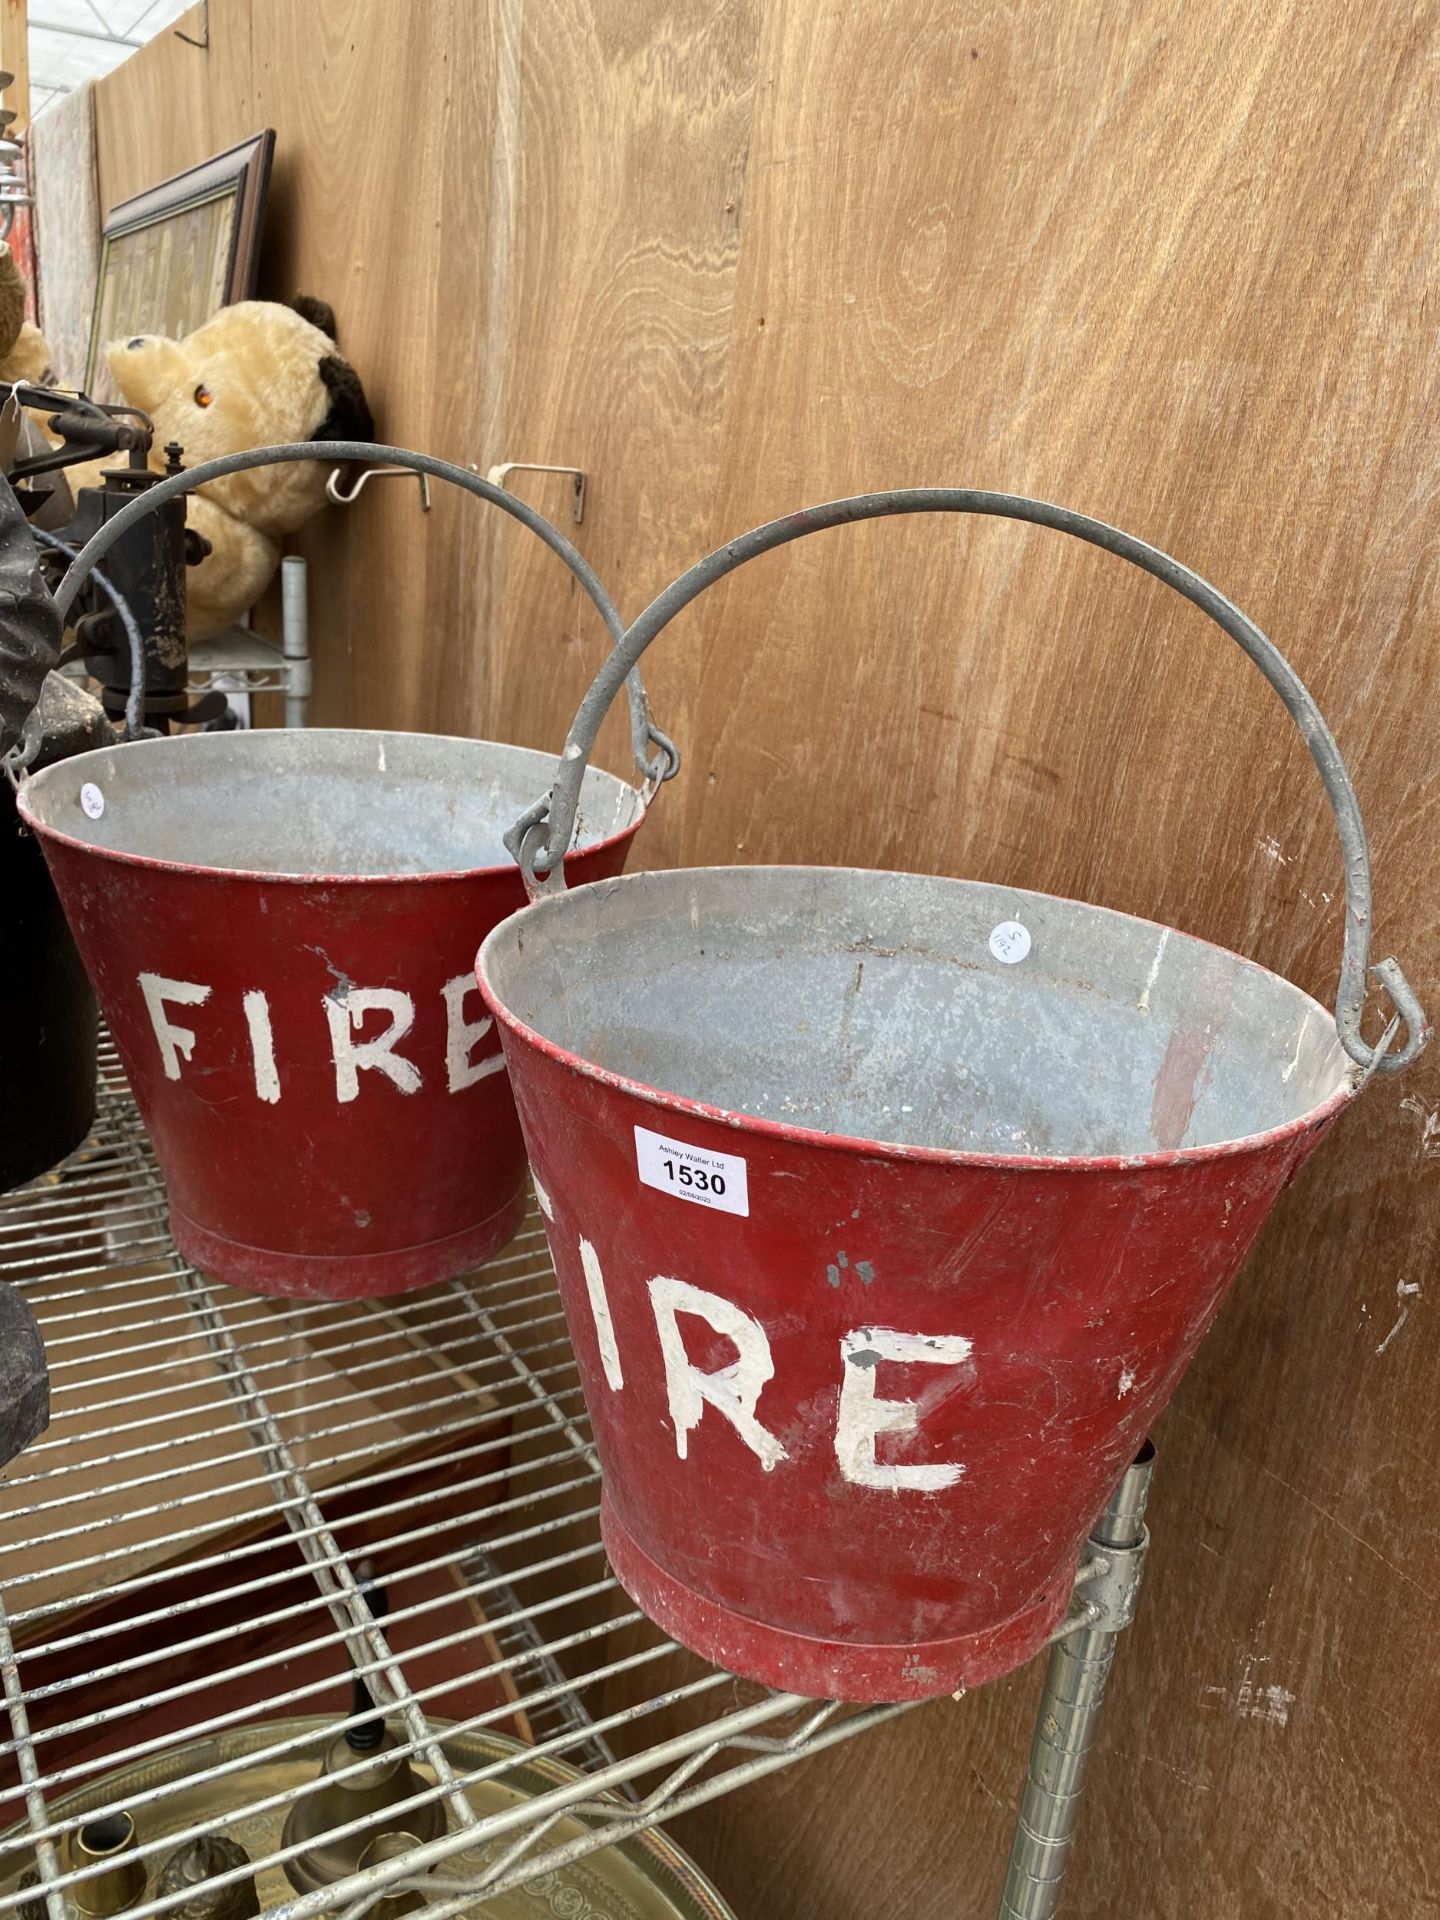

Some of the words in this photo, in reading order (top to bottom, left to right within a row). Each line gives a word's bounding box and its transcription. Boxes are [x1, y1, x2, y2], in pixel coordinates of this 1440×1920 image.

[137, 972, 505, 1104] FIRE
[658, 1144, 684, 1159] Ashley
[685, 1152, 710, 1166] Waller
[711, 1160, 725, 1170] Ltd
[663, 1160, 726, 1196] 1530
[528, 1162, 974, 1493] IRE
